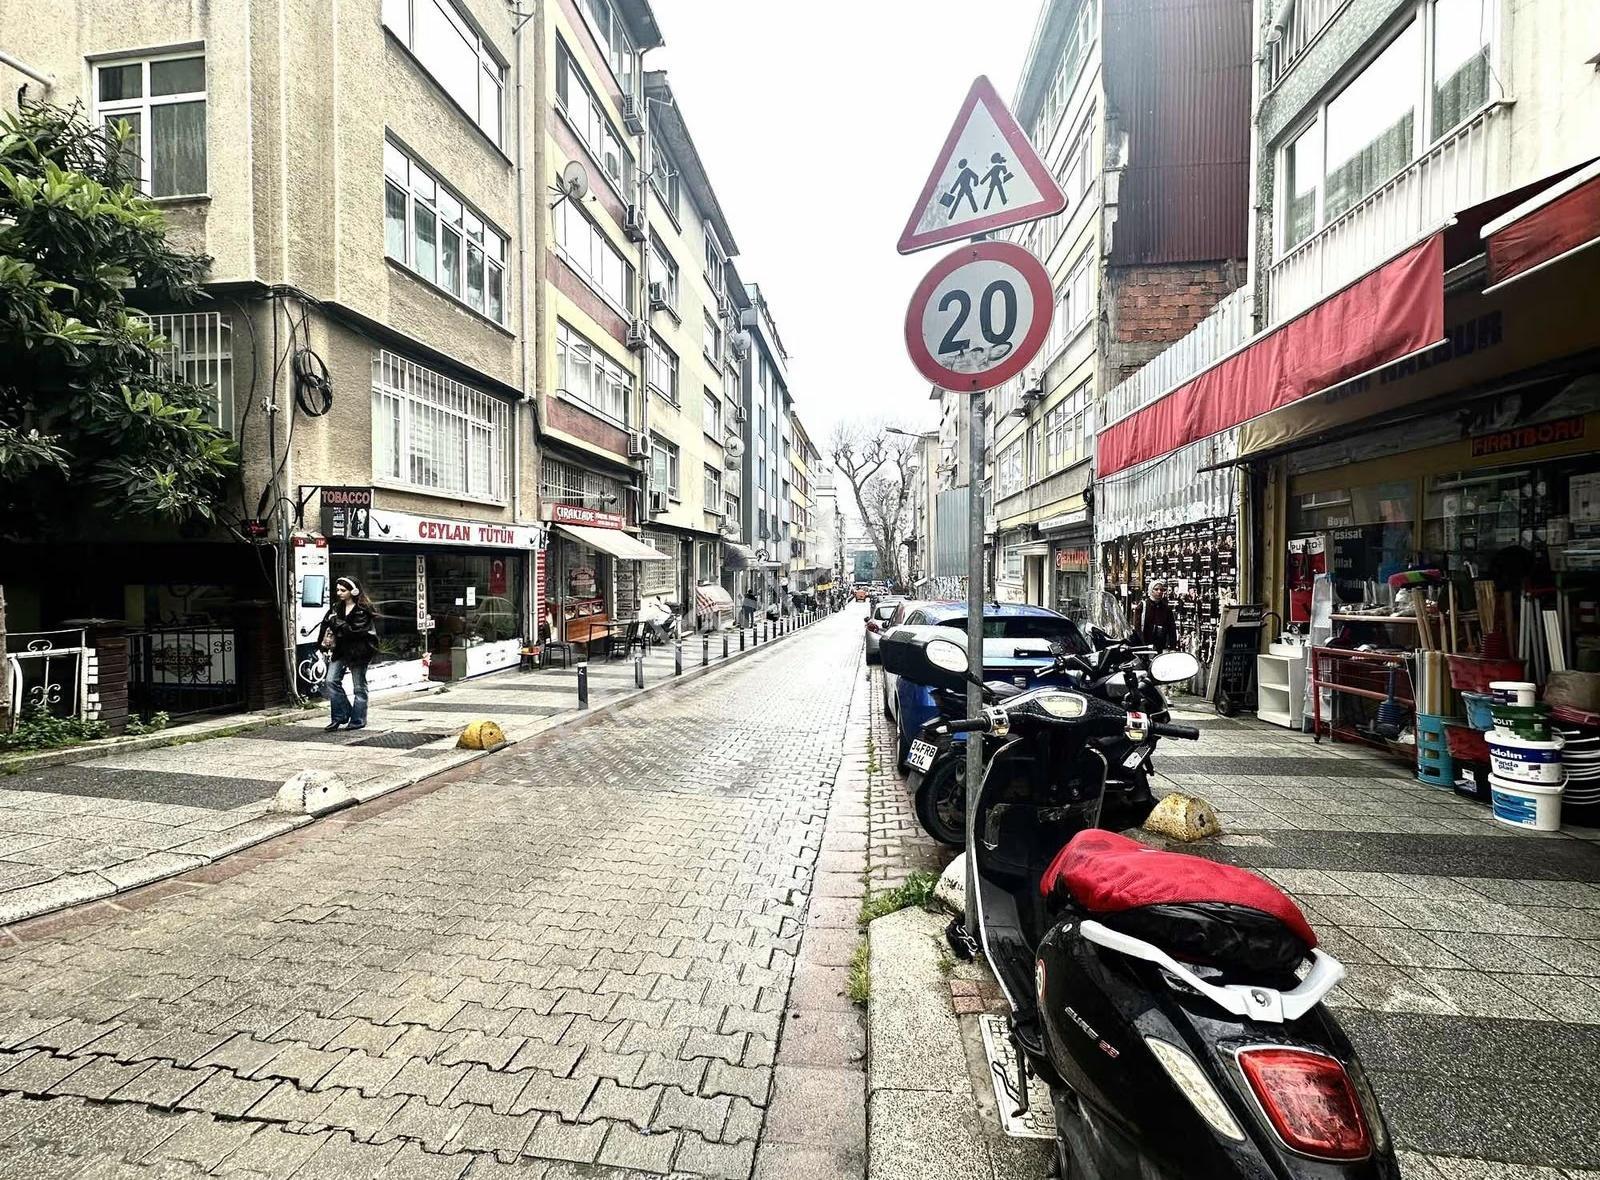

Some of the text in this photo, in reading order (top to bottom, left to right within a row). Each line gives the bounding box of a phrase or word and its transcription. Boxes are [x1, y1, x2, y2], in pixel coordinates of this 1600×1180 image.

[938, 280, 1018, 355] 20
[321, 490, 371, 504] TOBACCO
[418, 521, 515, 545] CEYLAN TÜTÜN
[911, 753, 925, 766] 214
[1495, 758, 1519, 768] Panda
